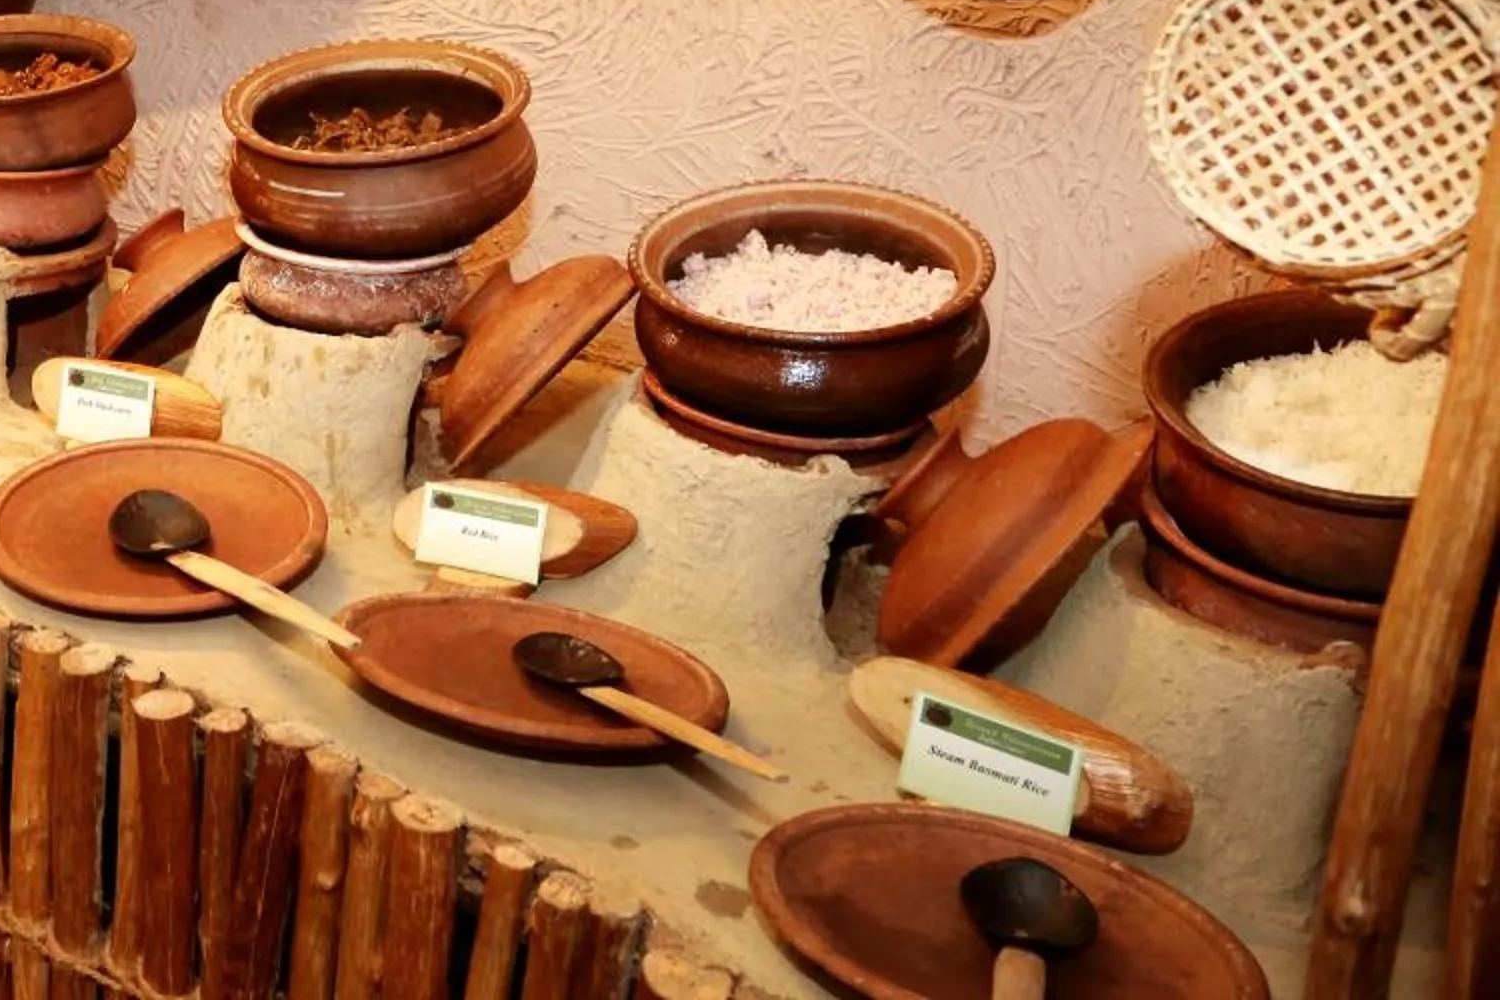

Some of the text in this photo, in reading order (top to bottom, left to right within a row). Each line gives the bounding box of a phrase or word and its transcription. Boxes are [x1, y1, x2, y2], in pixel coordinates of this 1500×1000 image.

[927, 744, 965, 766] Steam
[968, 760, 1020, 787] Basmati
[1020, 778, 1050, 797] Rice
